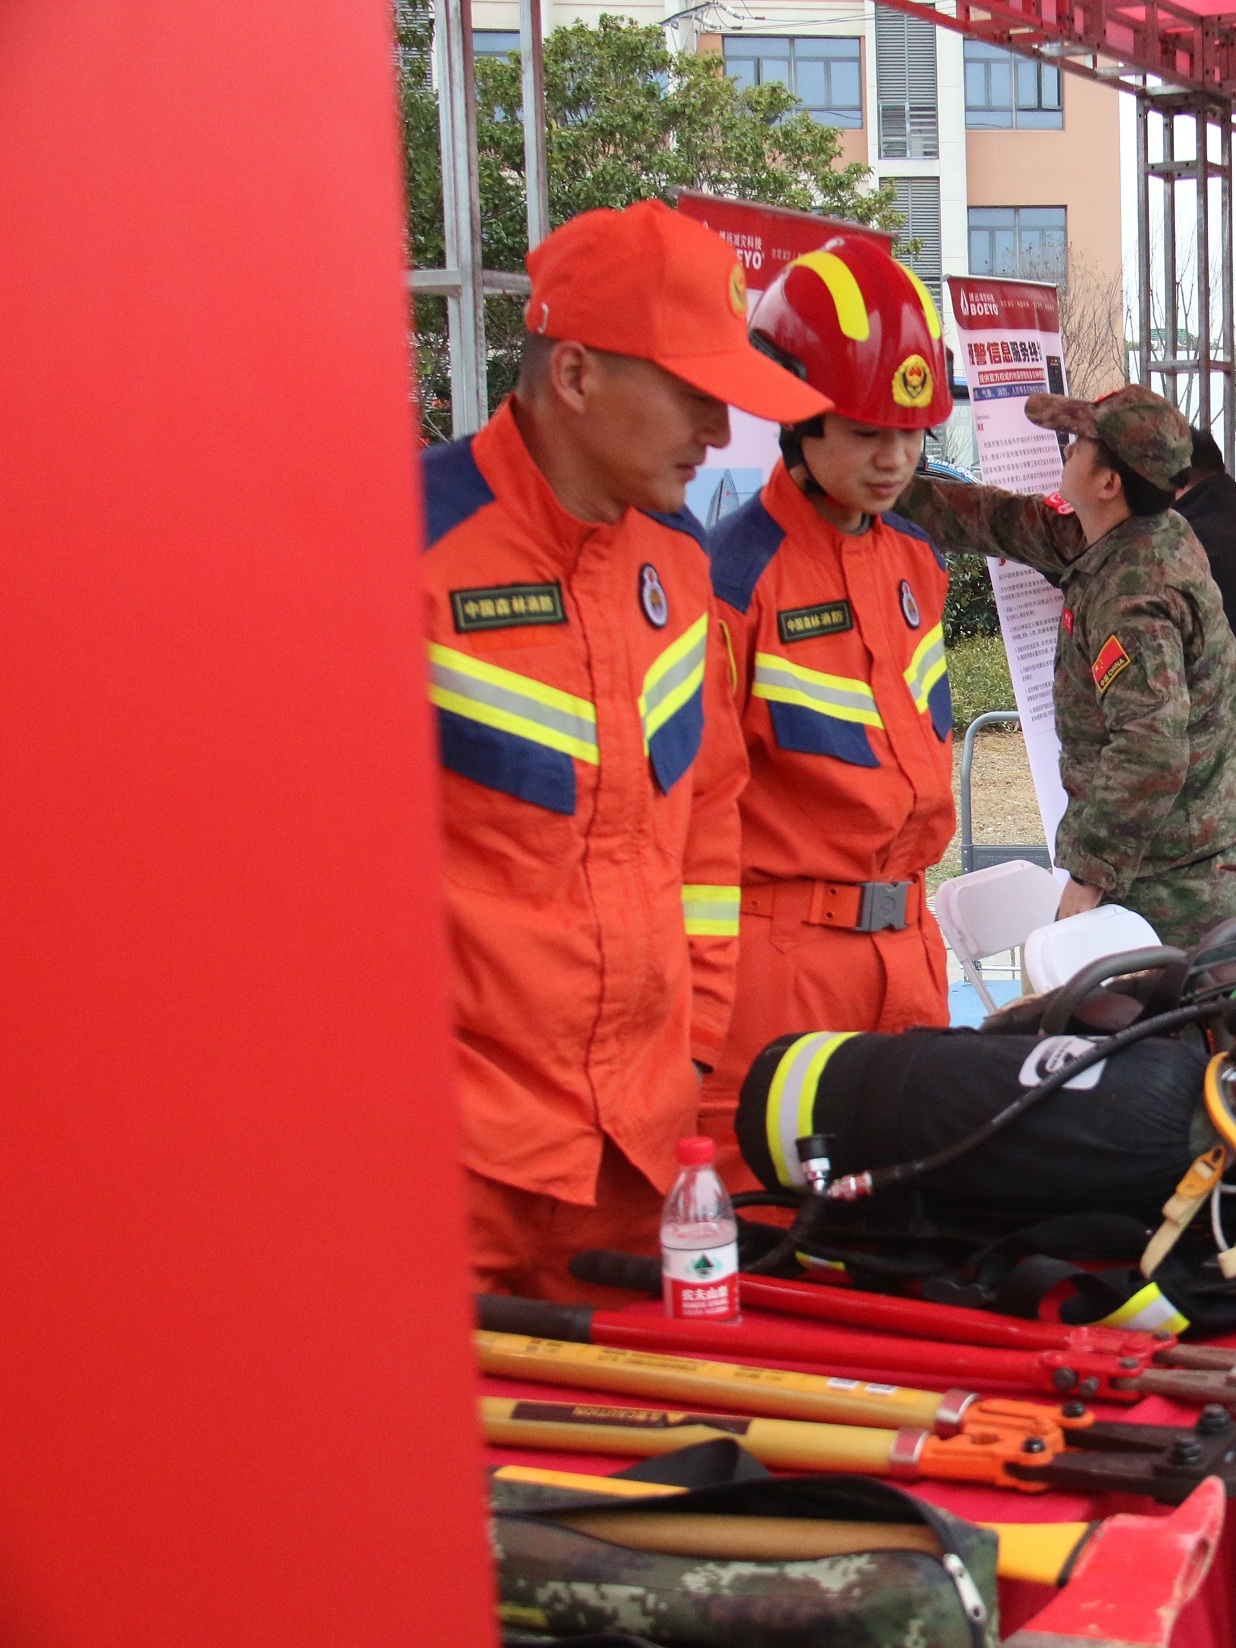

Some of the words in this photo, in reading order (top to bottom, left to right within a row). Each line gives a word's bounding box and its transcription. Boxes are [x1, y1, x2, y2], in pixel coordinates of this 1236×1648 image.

[736, 249, 762, 269] EYO
[969, 303, 999, 316] BOEYO
[463, 594, 555, 619] 中国森林消防
[786, 609, 844, 633] 中国森林消防
[1107, 658, 1126, 677] CHINA
[681, 1286, 729, 1302] 农夫山泉
